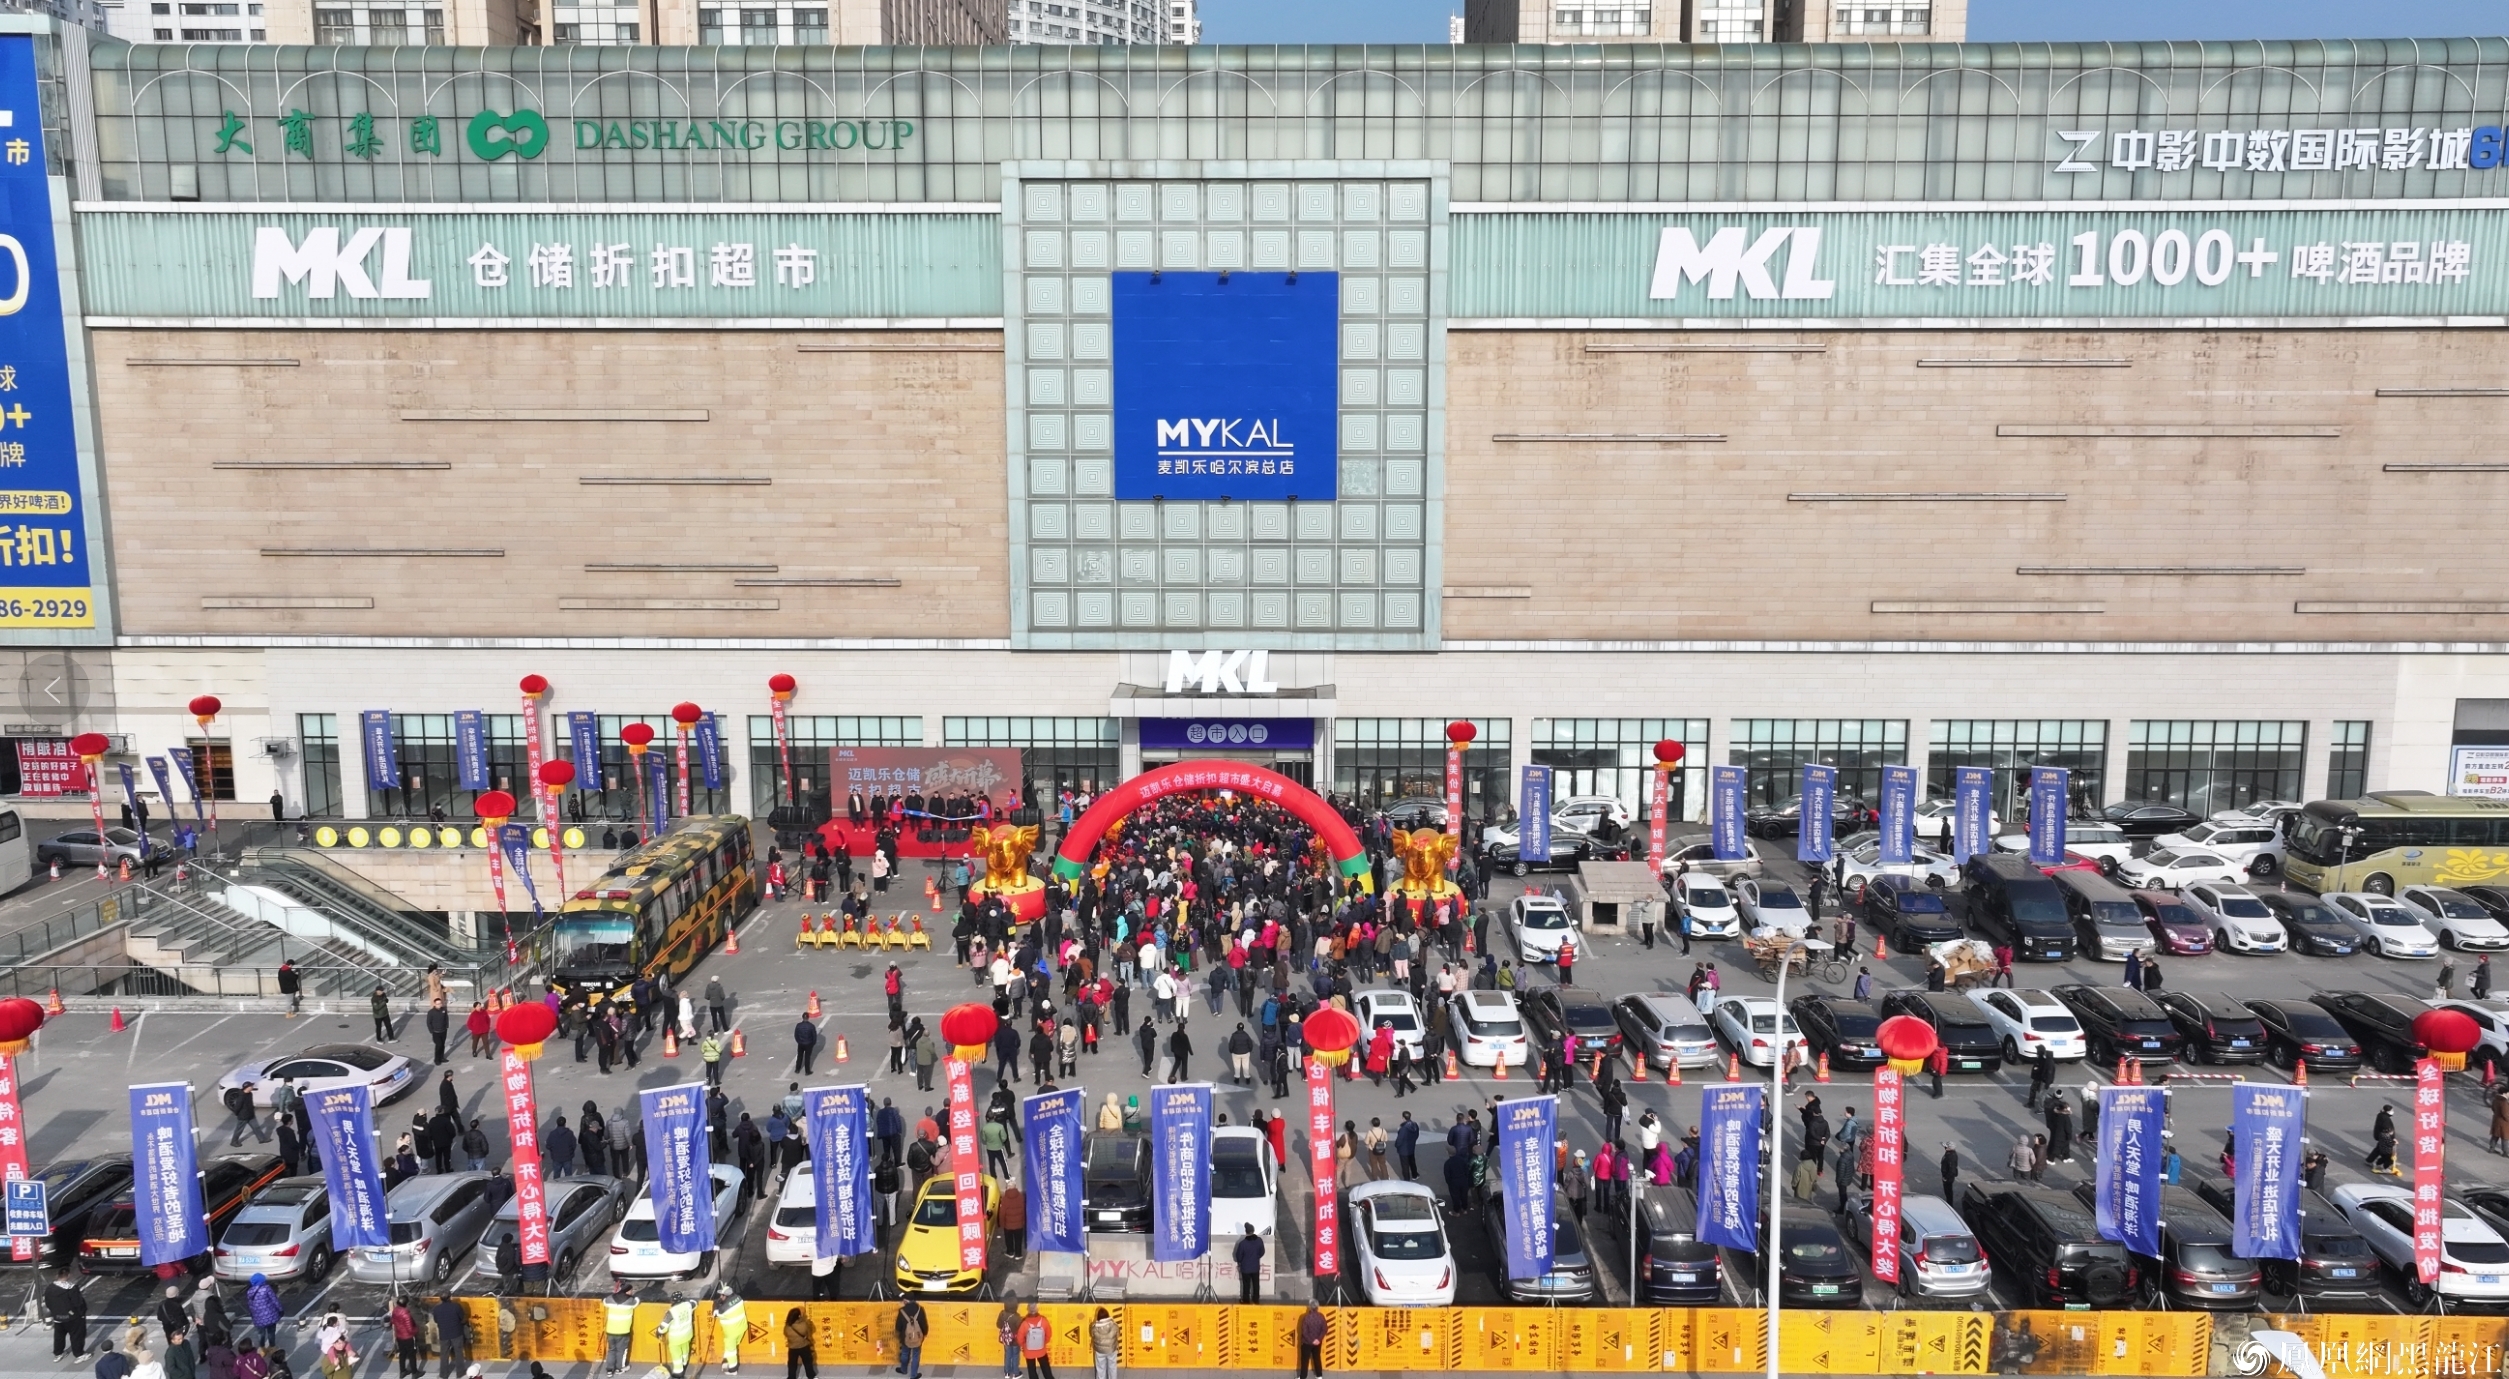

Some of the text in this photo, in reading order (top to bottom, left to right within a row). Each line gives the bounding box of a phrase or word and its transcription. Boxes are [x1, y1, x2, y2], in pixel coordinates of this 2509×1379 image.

[214, 109, 441, 160] 大商集团
[575, 119, 914, 151] DASHANG GROUP
[2111, 127, 2472, 172] 中影中数国际影城
[252, 227, 431, 300] MKL
[466, 242, 818, 289] 仓储折扣超市
[1648, 226, 1835, 300] MKL
[1874, 229, 2471, 288] 汇集全球 1000+ 啤酒品牌
[1157, 418, 1294, 448] MYKAL
[1157, 459, 1294, 475] 麦凯乐哈尔滨总店
[1166, 650, 1278, 693] MKL
[1190, 726, 1264, 740] 超市入口
[848, 767, 921, 782] 迈凯乐仓储
[19, 1185, 31, 1198] P
[1086, 1259, 1174, 1279] MYKAL
[1175, 1261, 1271, 1282] 哈尔滨店
